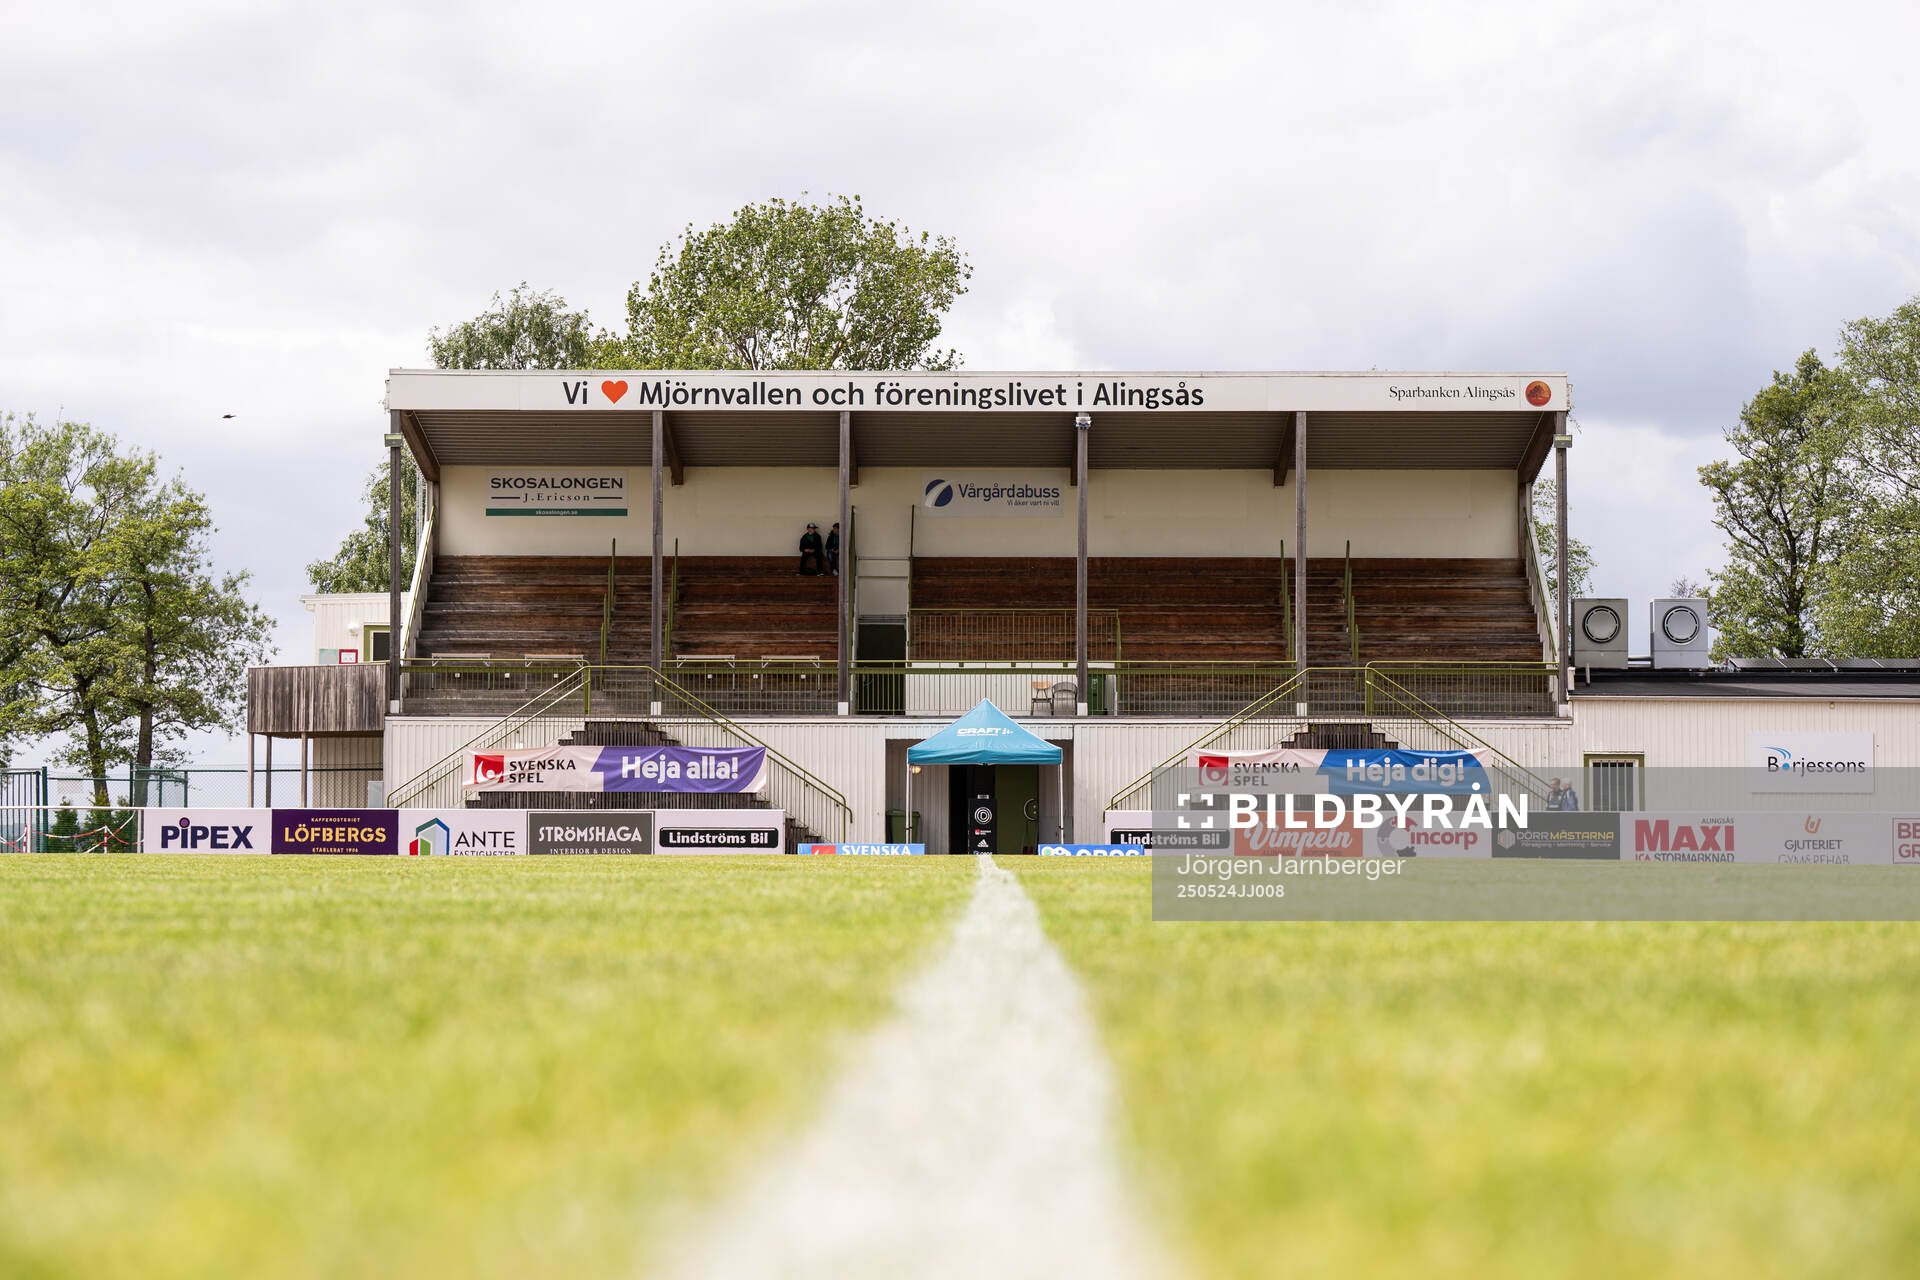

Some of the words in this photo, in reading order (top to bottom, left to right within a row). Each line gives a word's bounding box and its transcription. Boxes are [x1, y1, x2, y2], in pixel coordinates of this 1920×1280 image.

[563, 381, 588, 405] Vi
[639, 380, 801, 409] Mjörnvallen
[812, 381, 864, 405] och
[874, 381, 1067, 409] föreningslivet
[1077, 382, 1083, 405] i
[1093, 381, 1204, 409] Alingsås
[1389, 386, 1460, 401] Sparbanken
[1463, 386, 1516, 401] Alingsås
[491, 477, 623, 489] SKOSALONGEN
[958, 482, 1060, 501] Vårgårdabuss
[509, 759, 577, 772] SVENSKA
[621, 754, 681, 784] Heja
[686, 755, 739, 780] alla!
[1233, 762, 1301, 774] SVENSKA
[1346, 757, 1405, 787] Heja
[1411, 758, 1465, 787] dig!
[509, 772, 544, 784] SPEL
[1233, 775, 1269, 787] SPEL
[284, 823, 387, 843] LÖFBERGS
[455, 831, 516, 848] ANTE
[668, 832, 747, 844] Lindströms
[750, 832, 769, 844] Bil
[1120, 833, 1198, 845] Lindströms
[1202, 833, 1220, 845] Bil
[1243, 820, 1353, 857] Vimpeln
[1411, 831, 1478, 850] incorp
[1784, 839, 1843, 852] GJUTERIET
[550, 847, 590, 855] INTERIOR
[841, 845, 911, 855] SVENSKA
